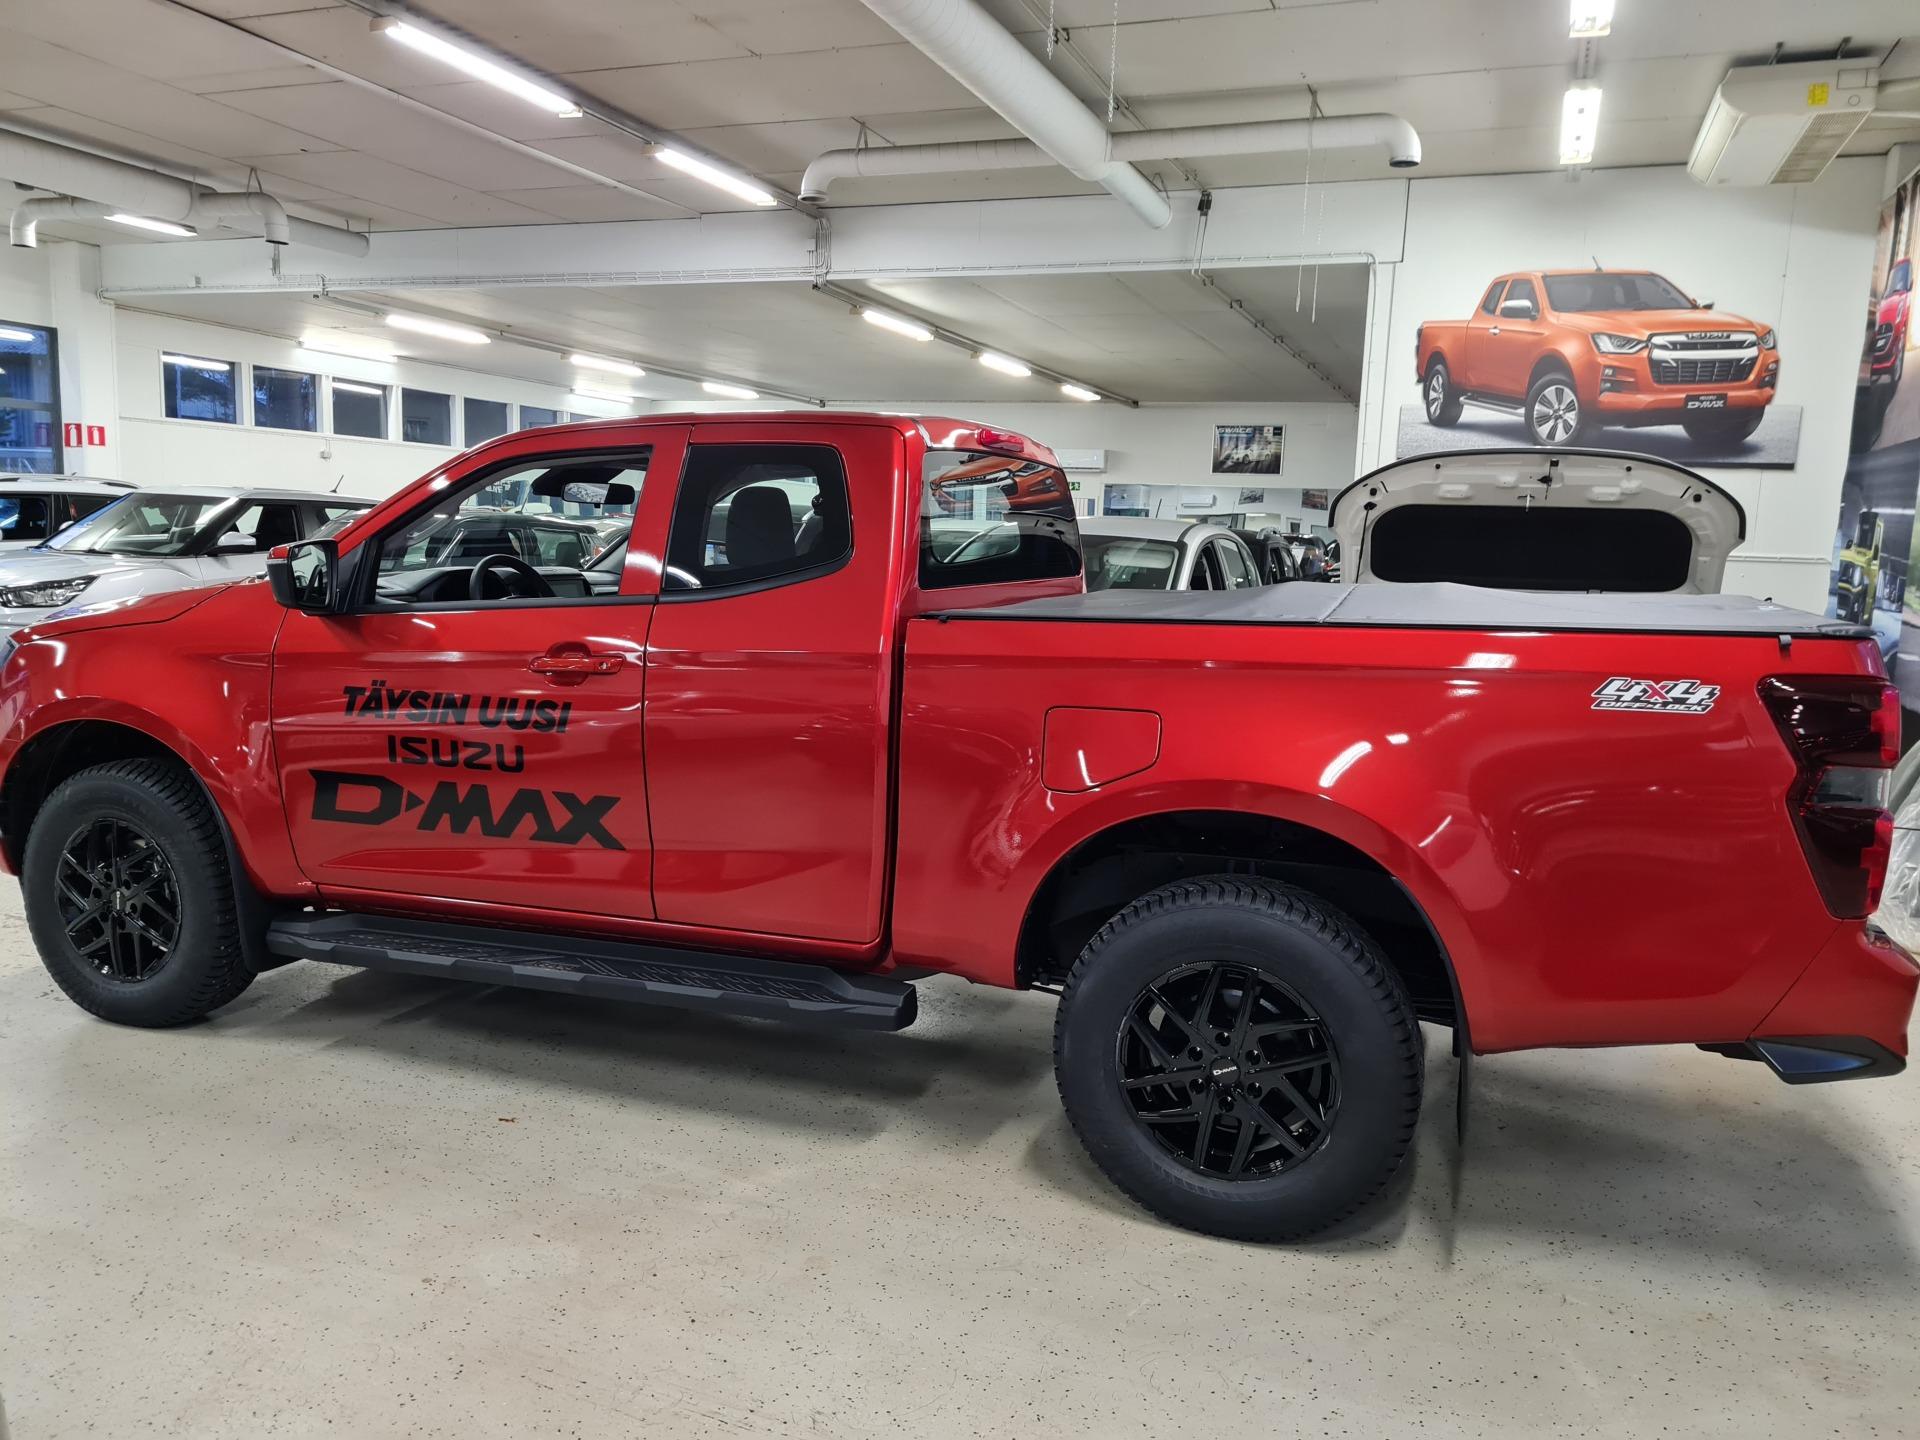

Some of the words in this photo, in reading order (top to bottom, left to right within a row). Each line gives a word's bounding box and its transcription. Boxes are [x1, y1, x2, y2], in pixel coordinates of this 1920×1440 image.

[343, 680, 471, 726] TÄYSIN
[477, 695, 573, 734] UUSI
[387, 735, 525, 773] ISUZU
